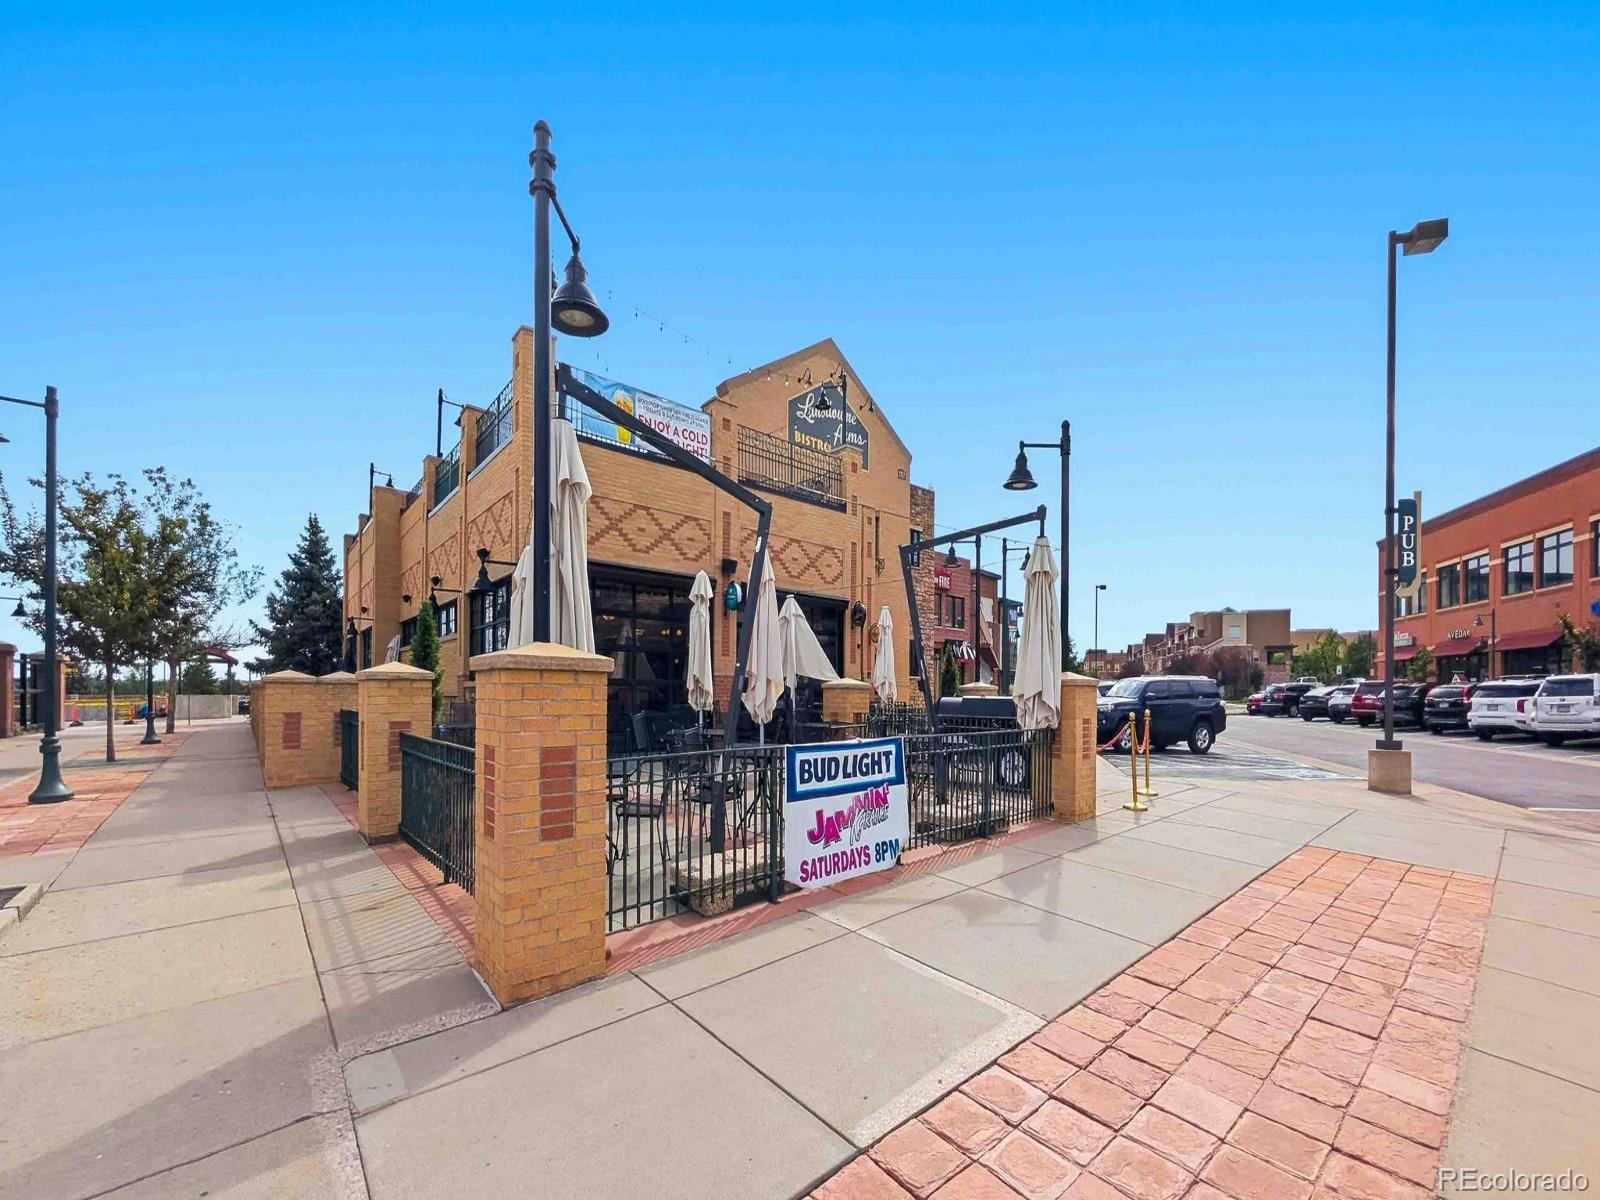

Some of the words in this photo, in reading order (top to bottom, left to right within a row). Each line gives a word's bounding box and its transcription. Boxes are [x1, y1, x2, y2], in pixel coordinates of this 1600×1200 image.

[673, 426, 680, 437] A
[682, 428, 708, 445] COLD
[795, 431, 831, 453] BISTRO
[1402, 515, 1416, 567] PUB
[799, 756, 840, 785] BUD
[843, 750, 892, 778] LIGHT
[800, 845, 871, 883] SATURDAYS
[874, 838, 899, 863] 8PM
